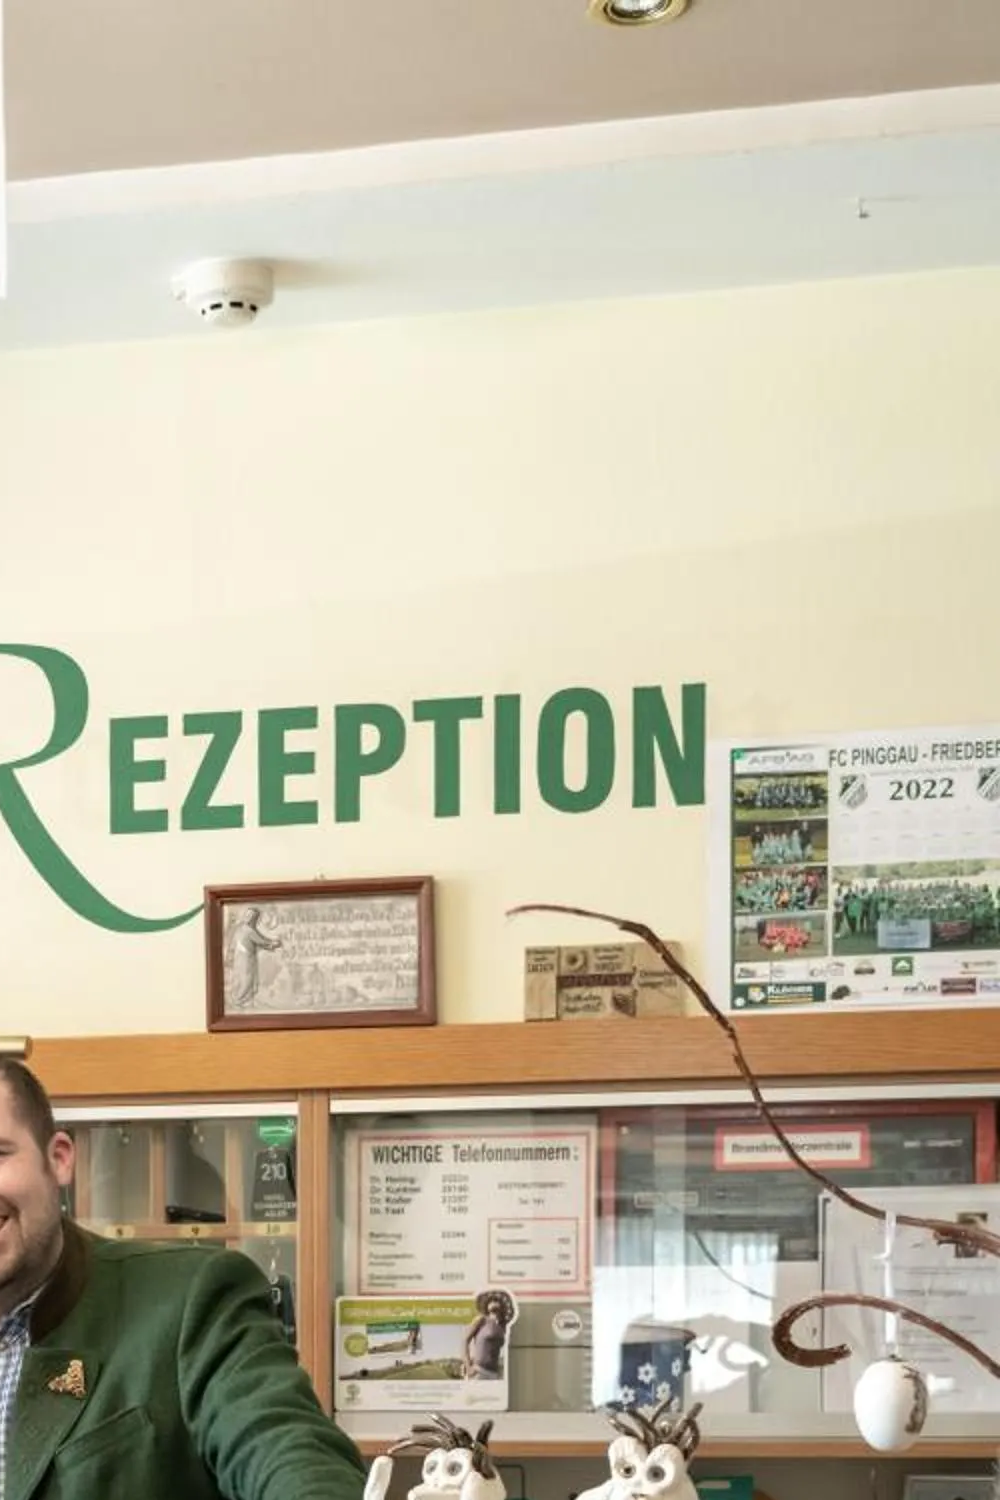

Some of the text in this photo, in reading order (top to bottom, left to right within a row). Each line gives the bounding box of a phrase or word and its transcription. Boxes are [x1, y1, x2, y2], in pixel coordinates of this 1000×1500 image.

[829, 750, 849, 768] FC
[851, 745, 919, 766] PINGGAU
[889, 778, 955, 801] 2022
[372, 1144, 443, 1165] WICHTIGE
[261, 1162, 287, 1182] 210
